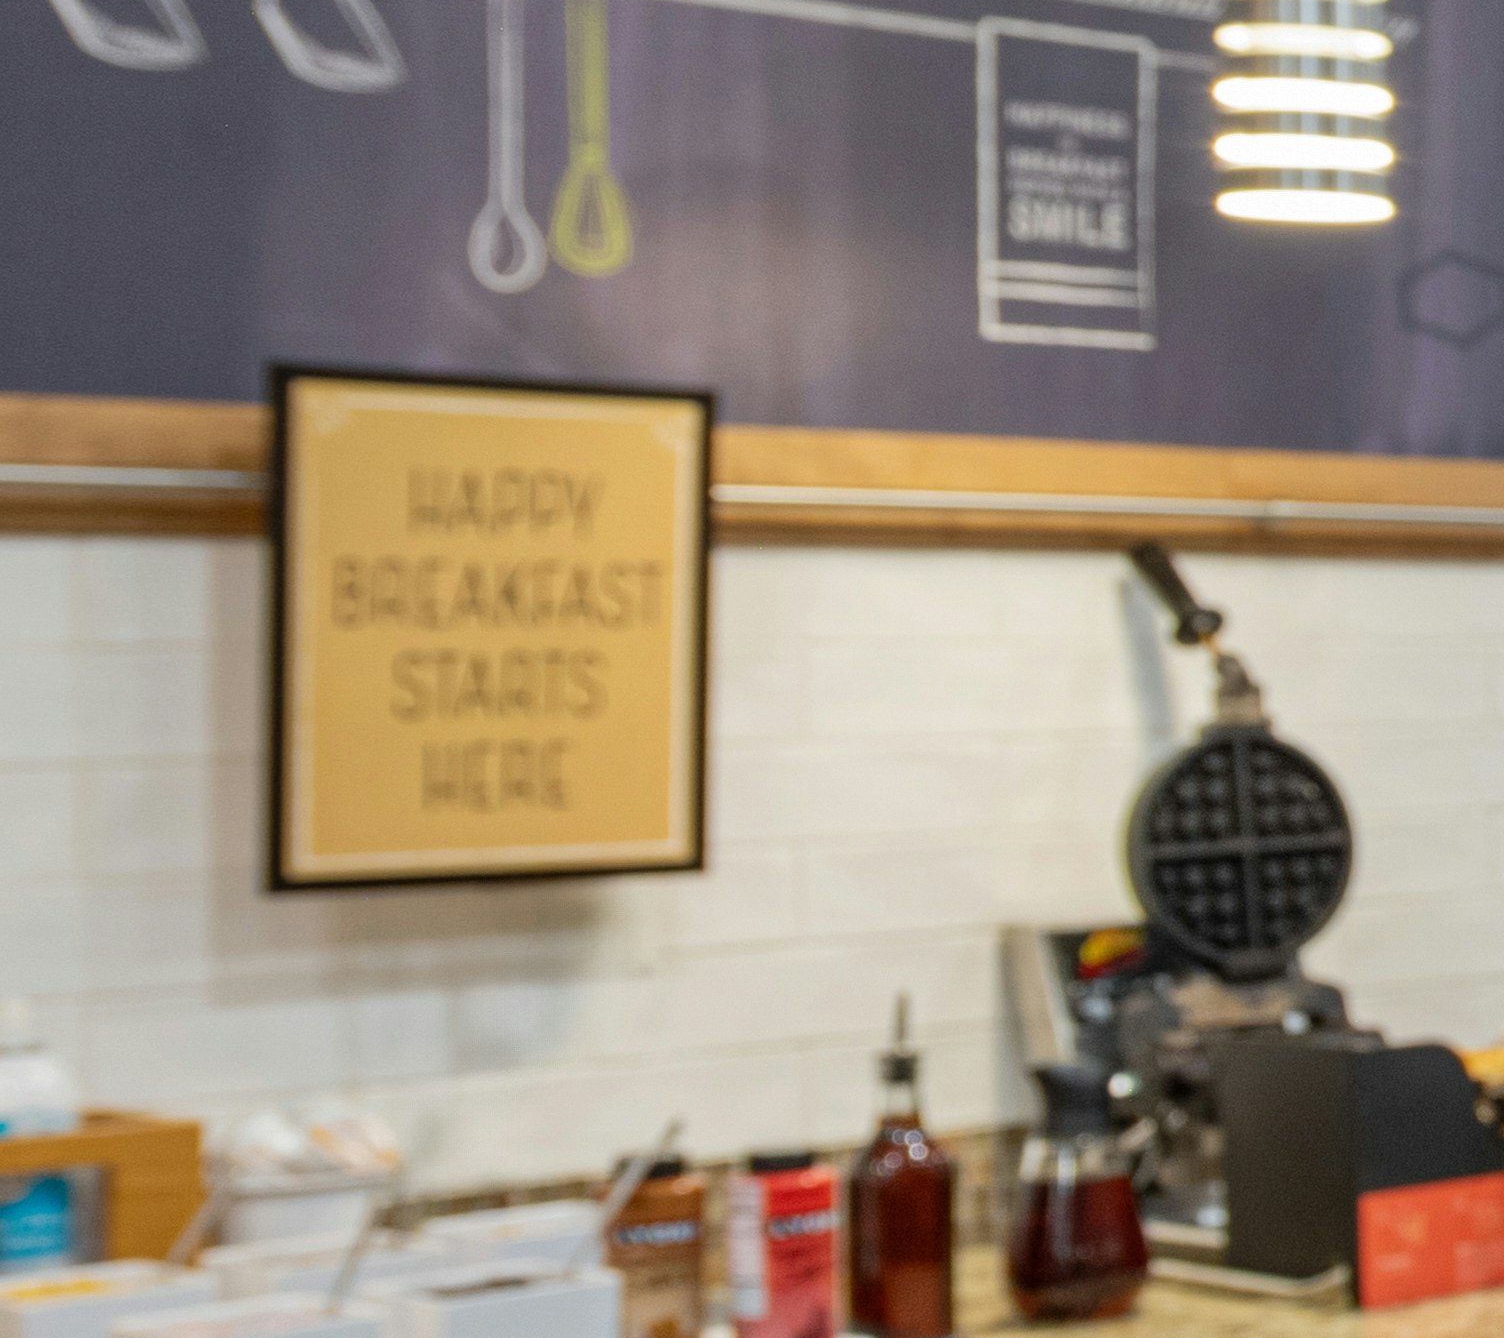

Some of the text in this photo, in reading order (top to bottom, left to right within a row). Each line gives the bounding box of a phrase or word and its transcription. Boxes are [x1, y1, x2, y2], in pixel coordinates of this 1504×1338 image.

[1008, 197, 1130, 249] SMILE
[406, 465, 606, 539] HAPPY
[330, 554, 663, 631] BREAKFAST
[389, 647, 609, 721] STARTS
[421, 739, 573, 813] HERE
